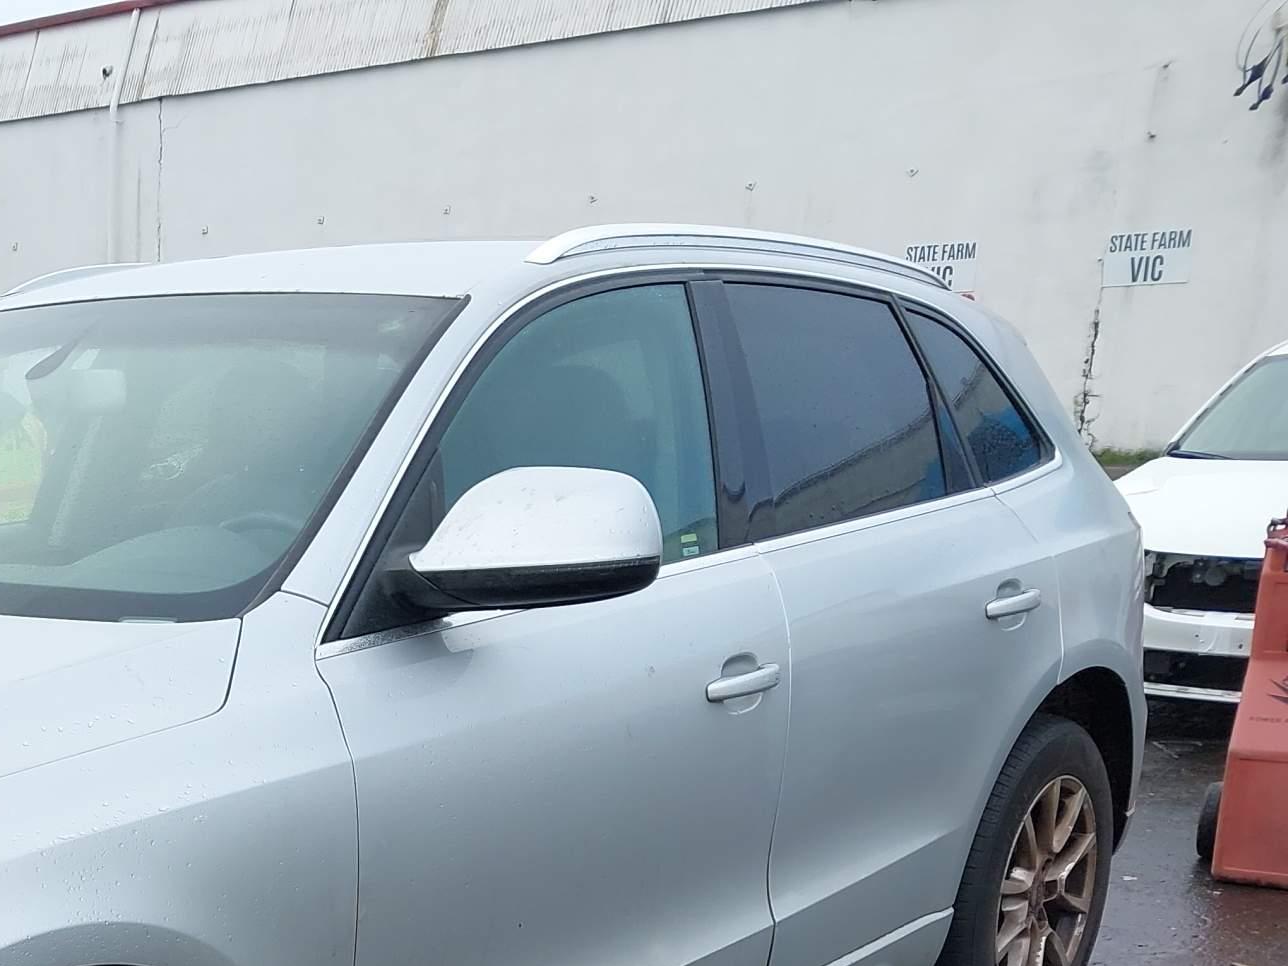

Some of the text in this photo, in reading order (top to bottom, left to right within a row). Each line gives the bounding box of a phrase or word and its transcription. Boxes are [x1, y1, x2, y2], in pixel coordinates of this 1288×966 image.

[905, 242, 977, 263] STATE FARM
[1109, 229, 1192, 253] STATE FARM
[1130, 255, 1164, 282] VIC
